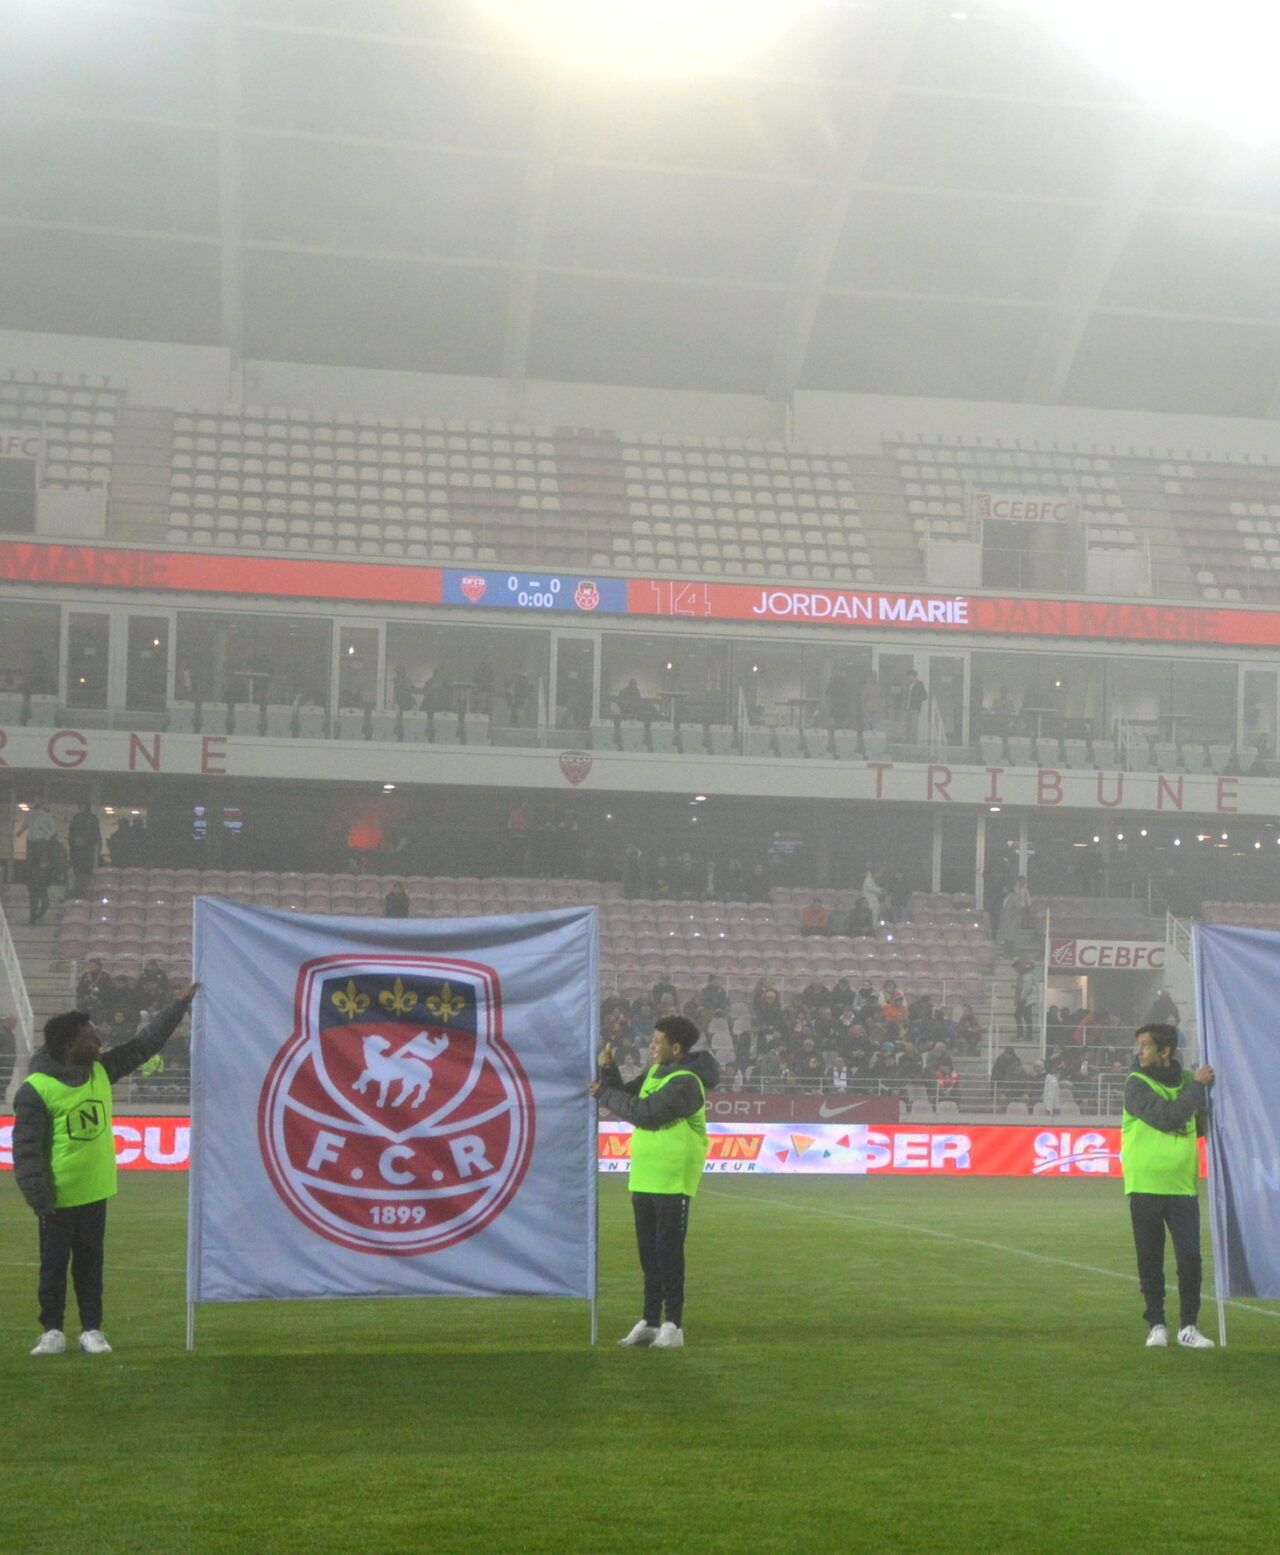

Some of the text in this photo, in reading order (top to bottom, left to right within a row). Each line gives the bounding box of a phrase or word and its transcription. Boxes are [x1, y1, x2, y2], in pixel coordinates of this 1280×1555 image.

[992, 499, 1069, 522] CEBFC
[507, 575, 519, 592] 0
[550, 578, 561, 594] 0
[517, 591, 554, 608] 0:00
[651, 580, 712, 617] 14
[752, 591, 968, 624] JORDAN MARIÉ
[867, 762, 1239, 813] TRIBUNE
[1080, 945, 1165, 969] CEBFC
[80, 1106, 98, 1129] N
[369, 1206, 426, 1225] 1899
